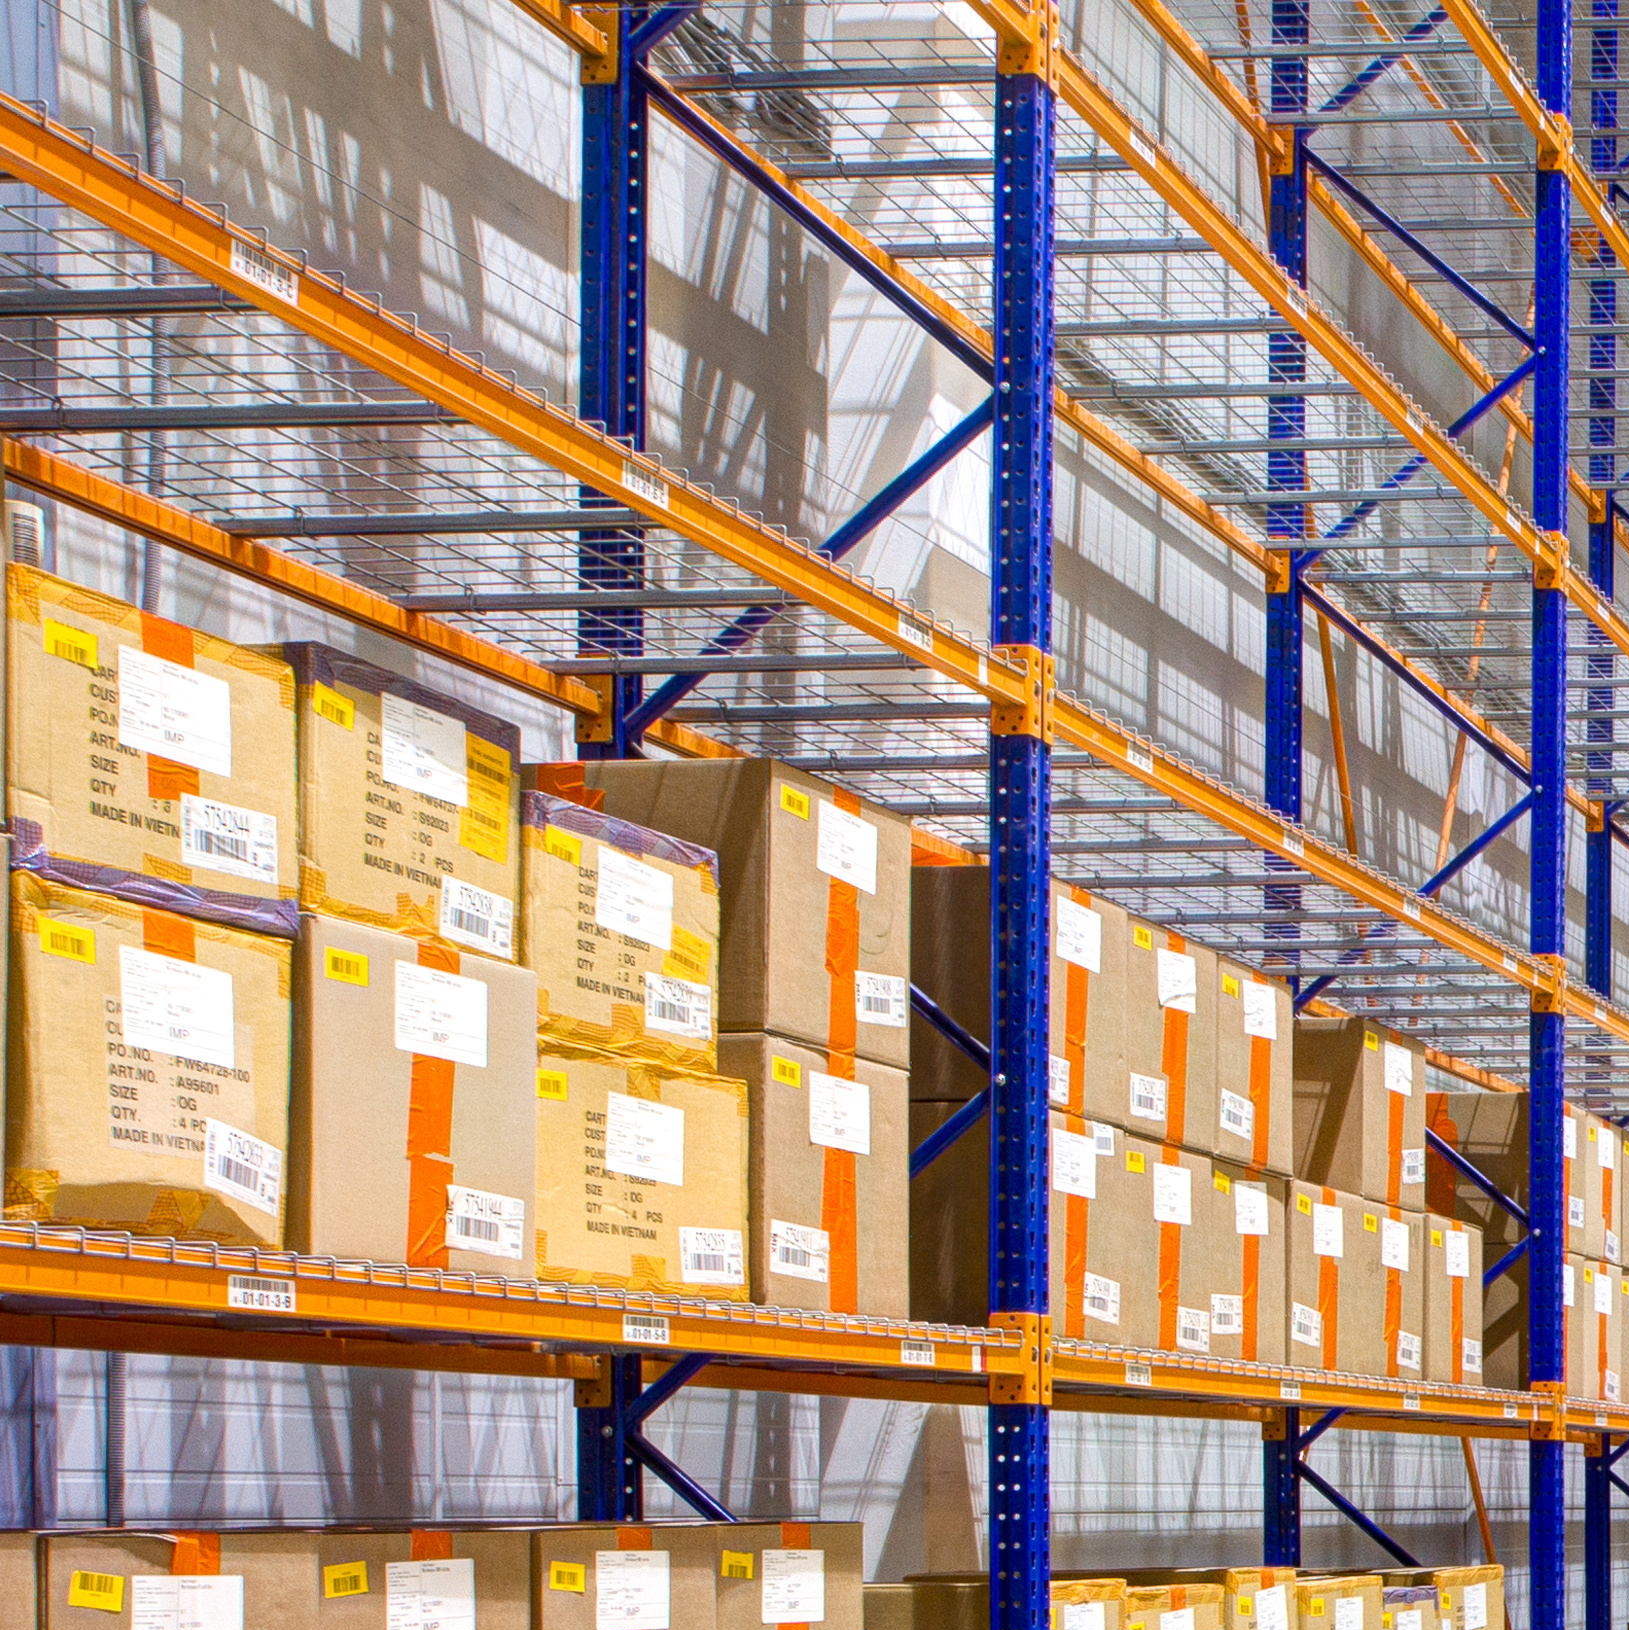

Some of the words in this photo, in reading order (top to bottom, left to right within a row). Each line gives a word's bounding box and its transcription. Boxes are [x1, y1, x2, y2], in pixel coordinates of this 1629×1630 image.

[164, 729, 186, 745] IMP
[90, 754, 119, 775] SIZE
[415, 766, 433, 780] IMP
[90, 778, 117, 797] QTY
[90, 801, 128, 823] MADE
[130, 812, 143, 829] IN
[365, 812, 387, 830] SIZE
[365, 833, 386, 849] QTY
[364, 852, 391, 873] MADE
[393, 862, 404, 877] IN
[577, 938, 596, 954] SIZE
[577, 974, 600, 992] MADE
[602, 982, 610, 995] IN
[168, 1026, 190, 1040] IMP
[108, 1063, 159, 1084] ART.NO.
[109, 1084, 139, 1102] SIZE
[111, 1105, 141, 1124] QTY.
[112, 1125, 149, 1144] MADE
[152, 1130, 163, 1145] IN
[585, 1183, 603, 1197] SIZE
[647, 1211, 663, 1224] PCS
[587, 1220, 610, 1234] MADE
[611, 1224, 620, 1235] IN
[621, 1226, 657, 1241] VIETNAM
